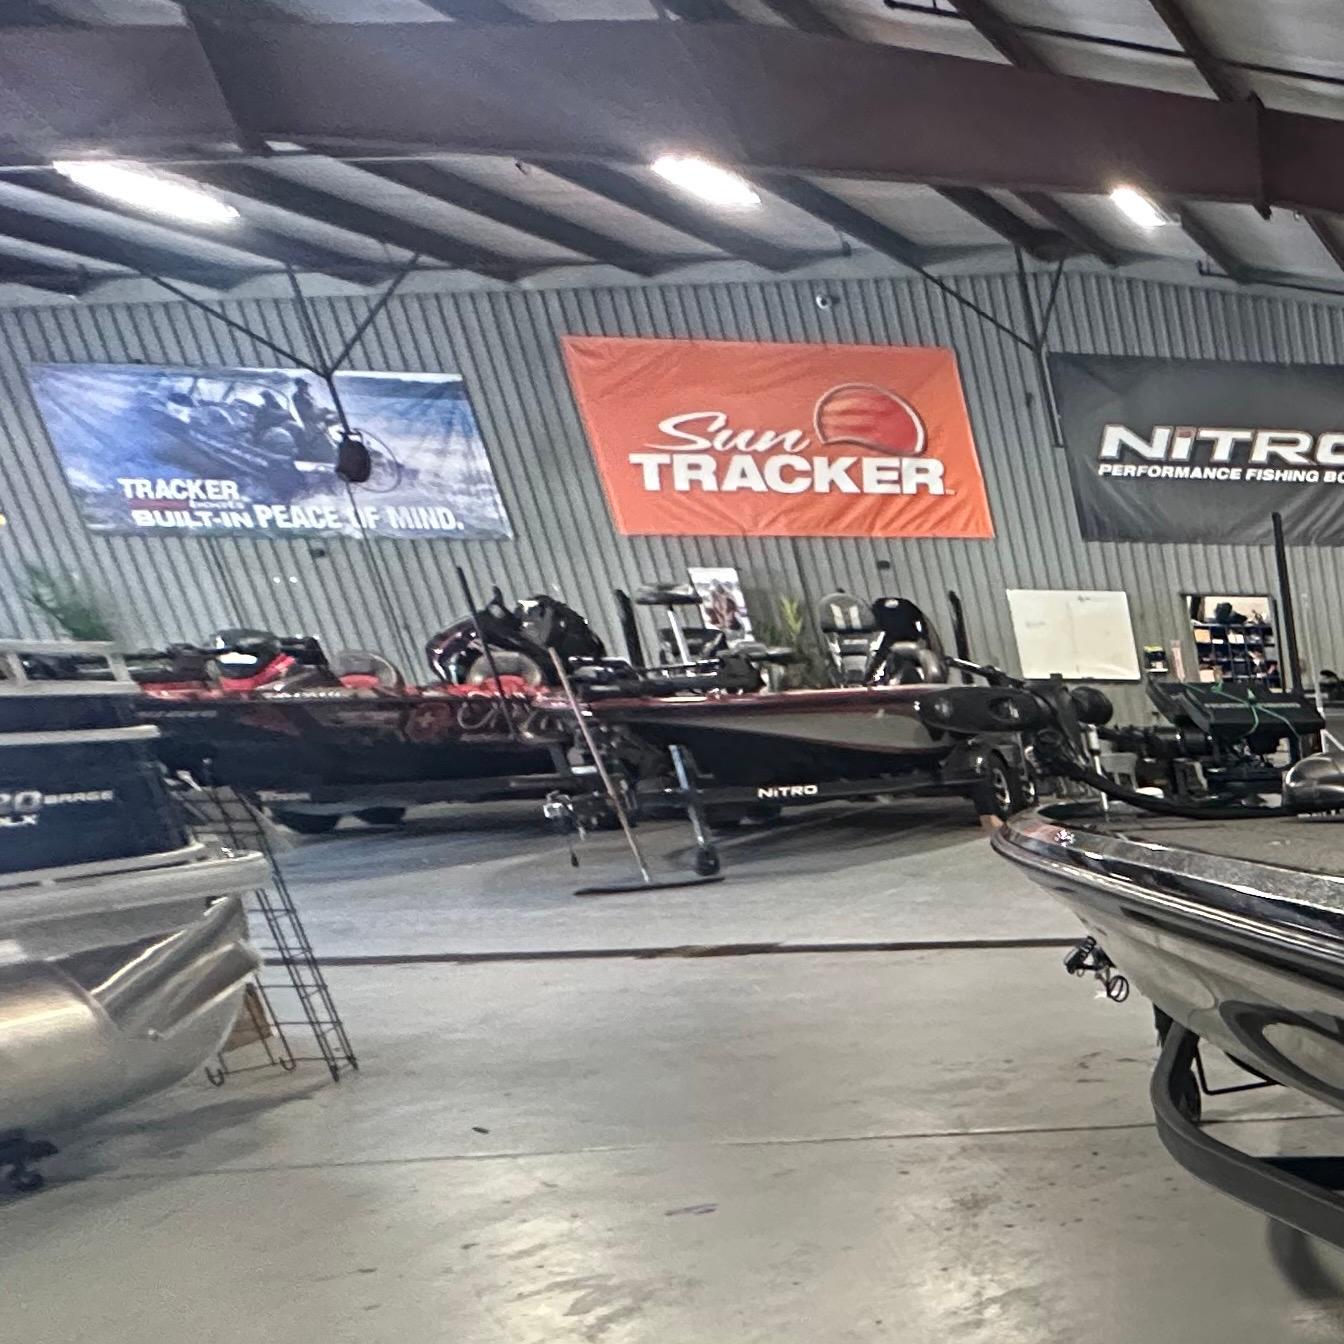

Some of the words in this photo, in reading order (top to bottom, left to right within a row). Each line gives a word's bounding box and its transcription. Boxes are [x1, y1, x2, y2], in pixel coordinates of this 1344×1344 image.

[646, 411, 811, 452] Sun
[628, 453, 946, 495] TRACKER
[1098, 464, 1241, 481] PERFORMANCE
[1246, 468, 1319, 482] FISHING
[117, 478, 240, 500] TRACKER
[131, 509, 254, 528] BUILT-IN
[252, 504, 343, 528] PEACE
[389, 507, 465, 530] MIND.
